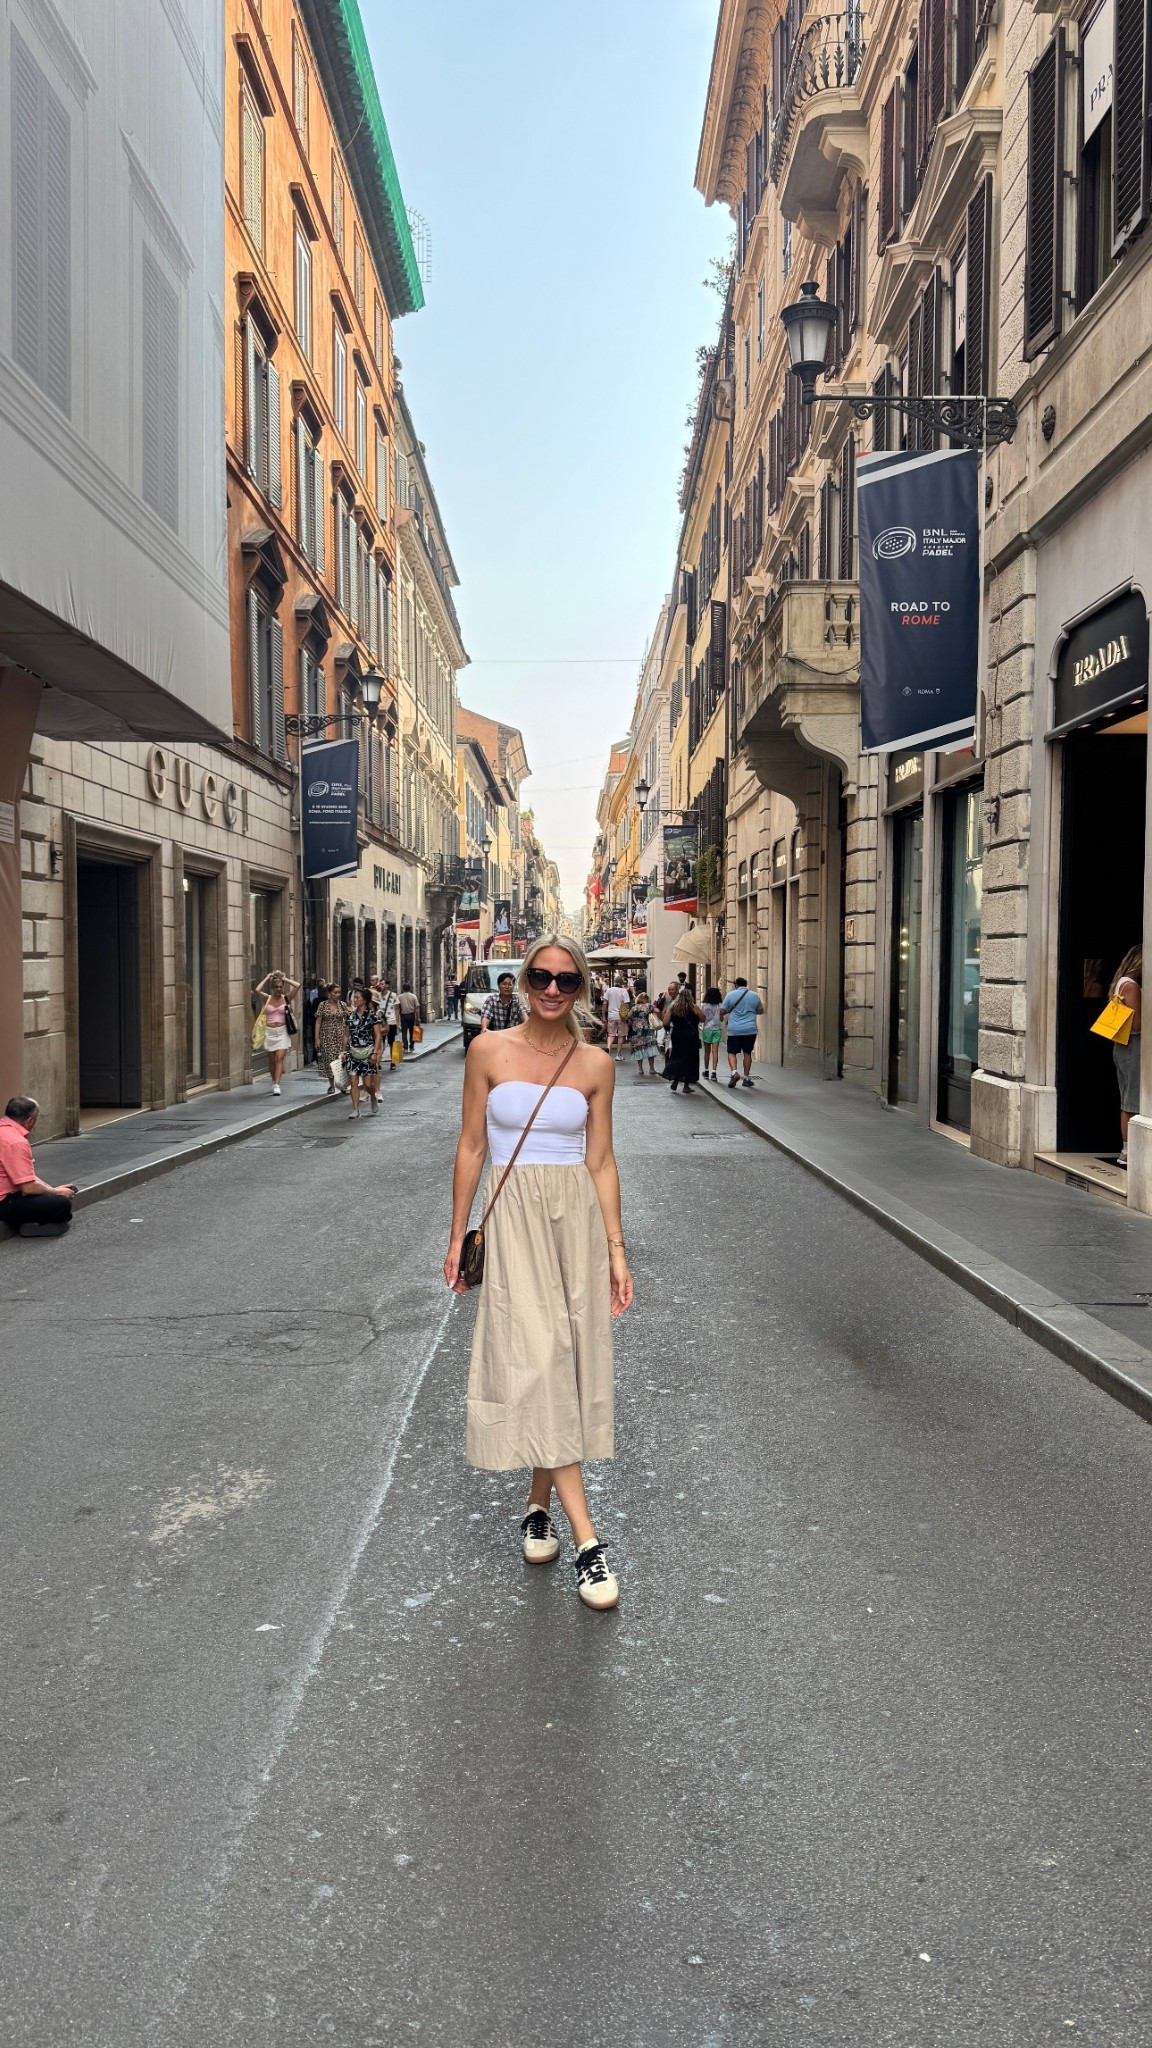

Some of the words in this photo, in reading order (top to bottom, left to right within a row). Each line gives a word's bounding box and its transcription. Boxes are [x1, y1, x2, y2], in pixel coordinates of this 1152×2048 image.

[922, 528, 948, 537] BNL
[922, 549, 954, 557] PADEL
[890, 601, 928, 612] ROAD
[932, 601, 951, 611] TO
[901, 614, 941, 625] ROME
[1073, 635, 1129, 686] PRADA
[146, 745, 249, 834] GUCCI
